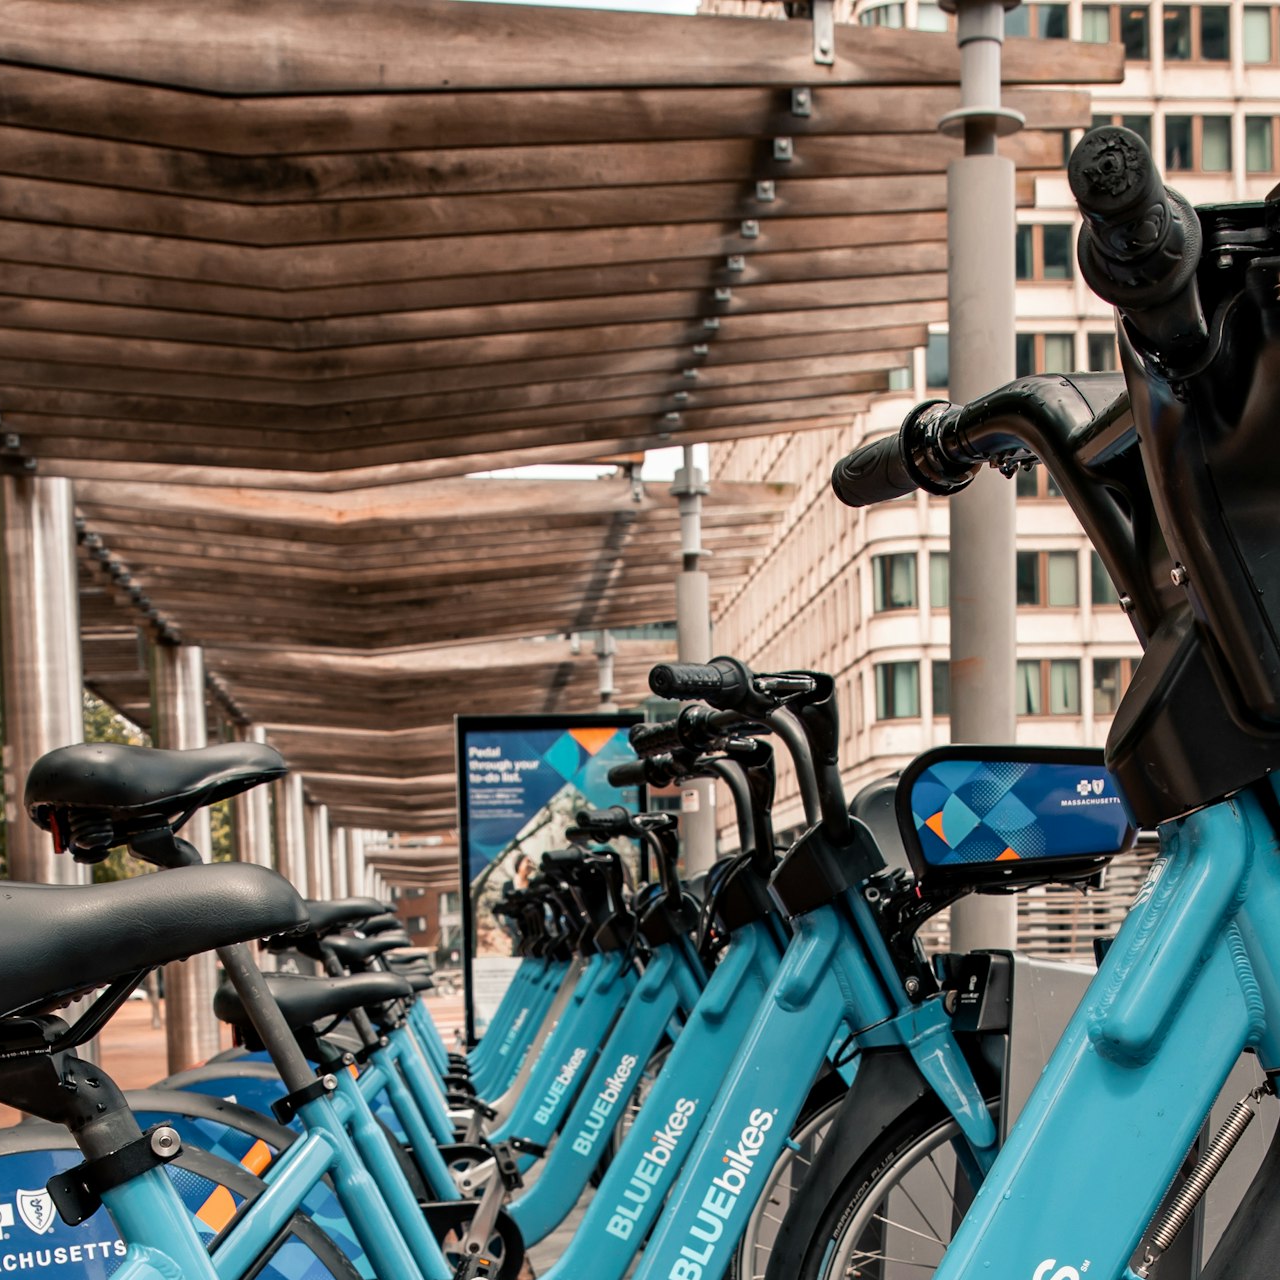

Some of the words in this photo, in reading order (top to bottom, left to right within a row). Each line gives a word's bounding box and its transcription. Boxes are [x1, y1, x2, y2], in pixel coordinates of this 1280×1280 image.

[469, 746, 502, 758] Pedal
[469, 760, 514, 771] through
[514, 760, 540, 771] your
[469, 773, 501, 783] to-do
[501, 772, 522, 783] list.
[533, 1048, 587, 1126] BLUEbikes
[573, 1054, 636, 1157] BLUEbikes
[606, 1097, 696, 1242] BLUEbikes
